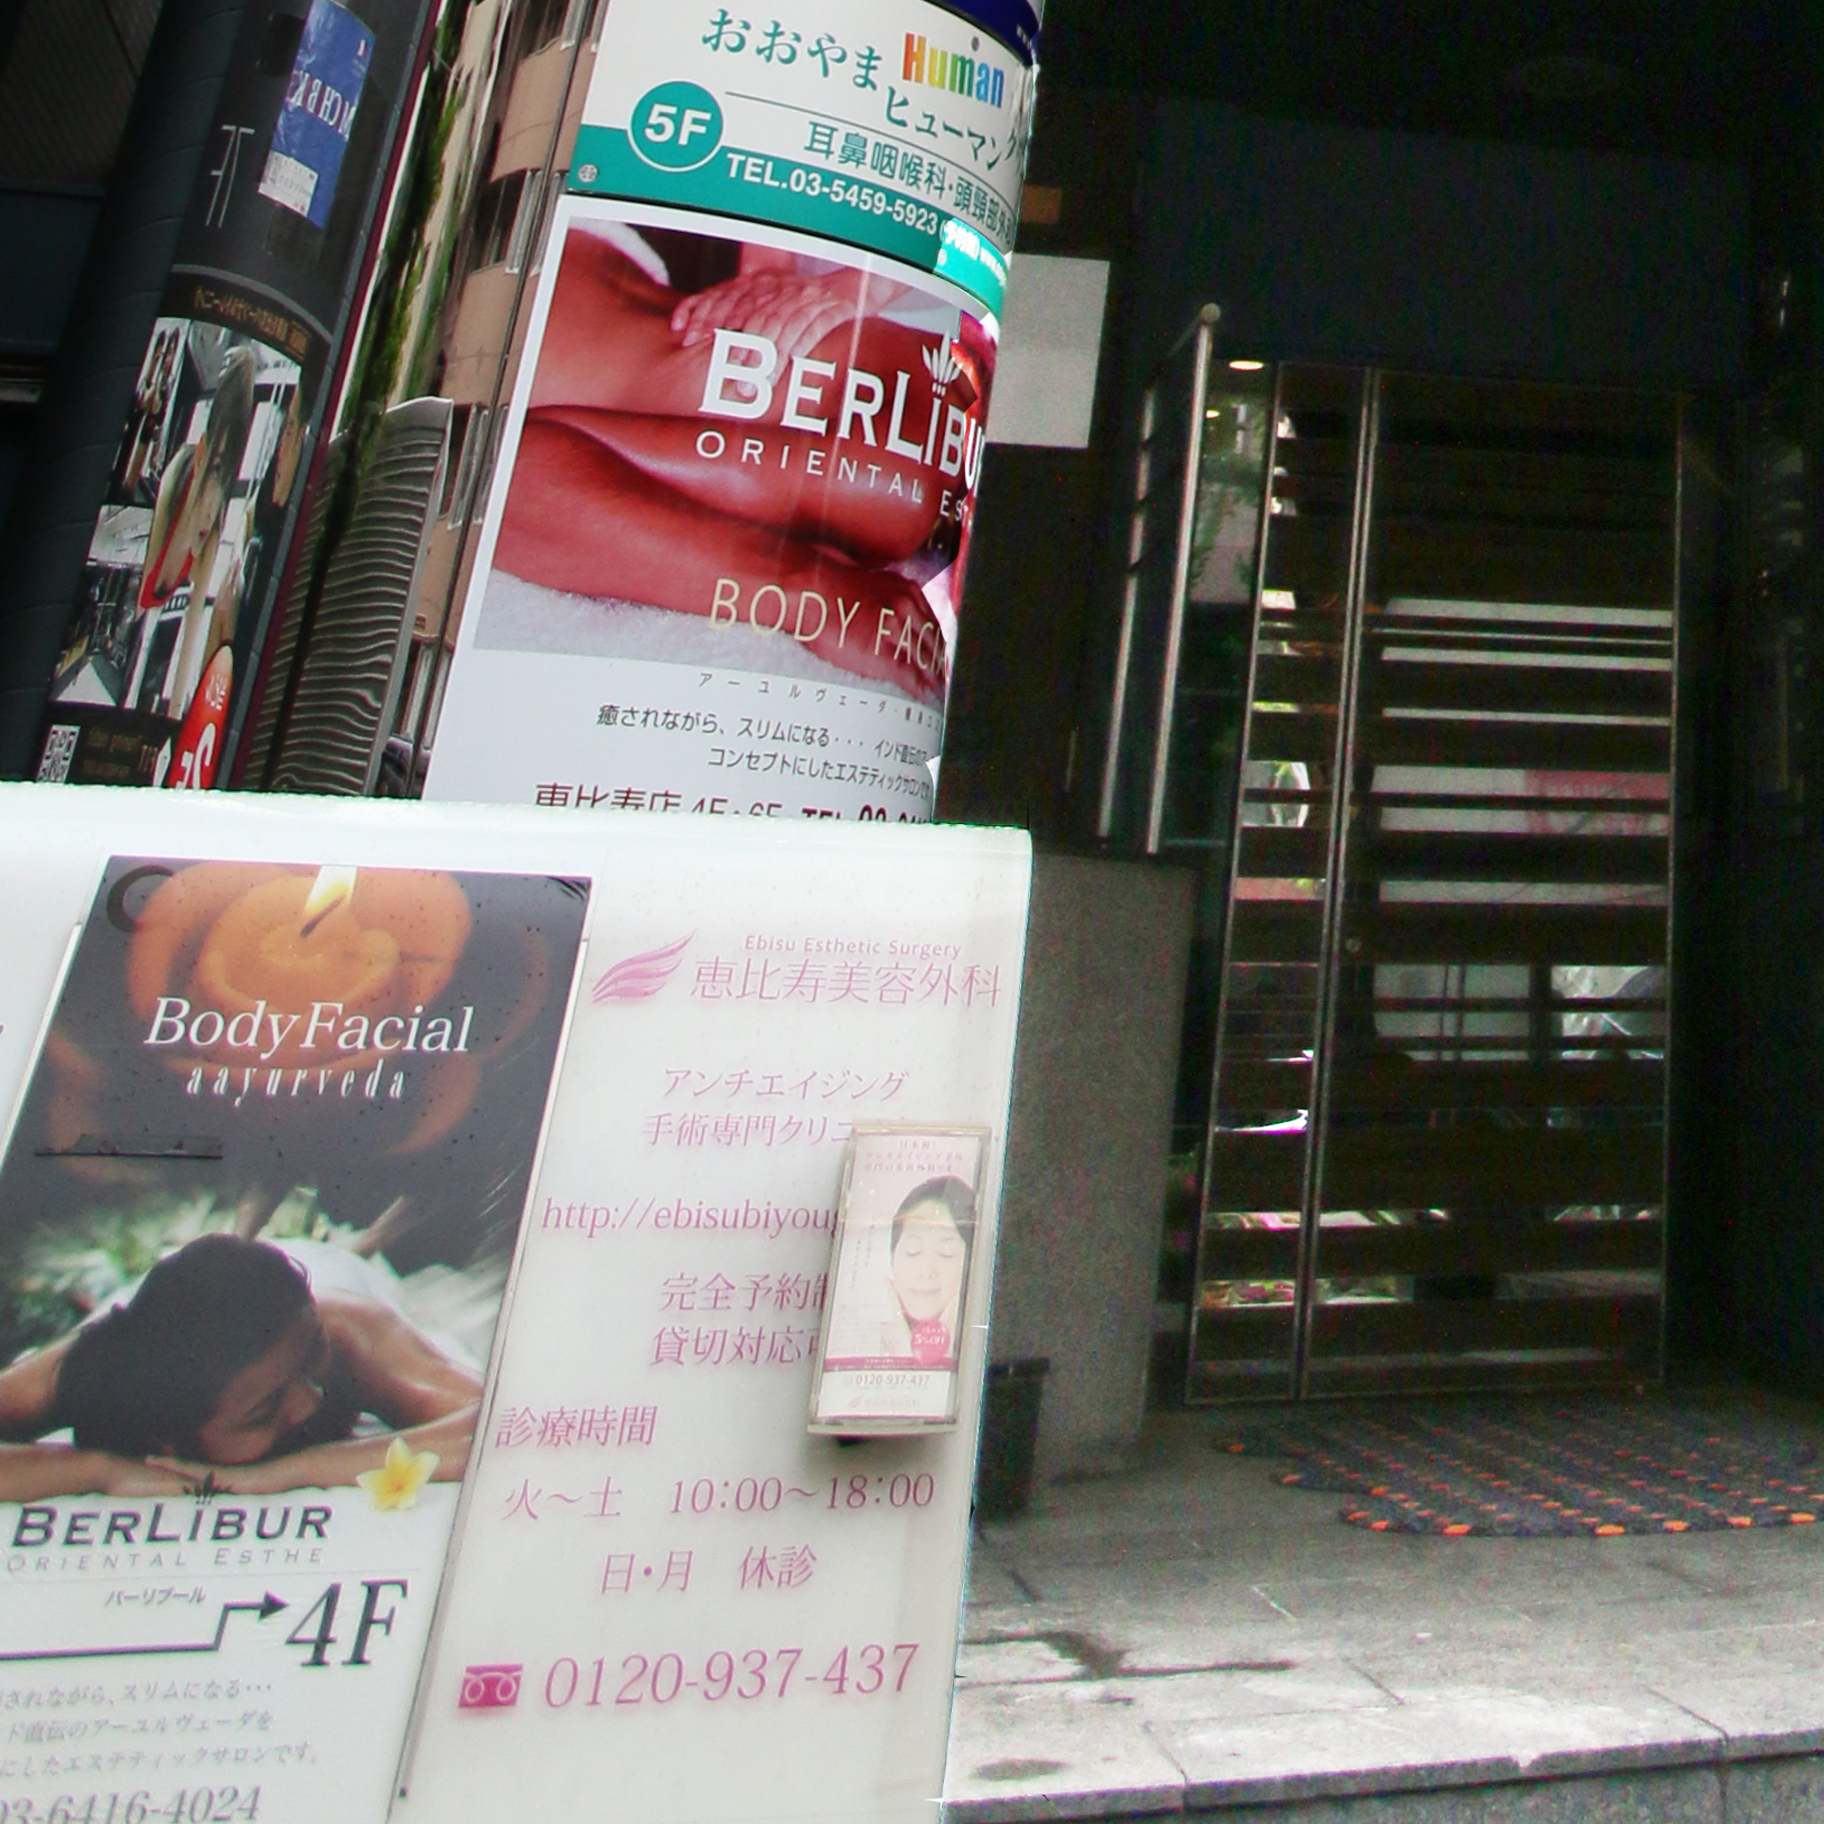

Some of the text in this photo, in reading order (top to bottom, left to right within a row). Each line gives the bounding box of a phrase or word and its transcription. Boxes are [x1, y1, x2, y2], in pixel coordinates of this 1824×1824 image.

[902, 32, 1005, 109] Human
[644, 102, 712, 148] 5F
[885, 85, 1021, 172] ヒューマンク
[695, 430, 924, 504] ORIENTAL
[708, 578, 861, 649] BODY
[744, 934, 963, 960] Ebisu Esthetic Surgery
[690, 955, 1002, 1008] 恵比寿美容外科
[186, 1058, 404, 1108] aayurveda
[662, 1067, 910, 1102] アンチエイジング
[641, 1112, 854, 1148] 手術専門クリニ
[495, 1405, 658, 1449] 診療時間
[12, 1502, 334, 1548] BERLIBUR
[7, 1547, 324, 1573] ORIENTAL ESTHE
[738, 1543, 819, 1591] 休診
[284, 1578, 409, 1668] 4F
[545, 1642, 920, 1709] 0120-937-437
